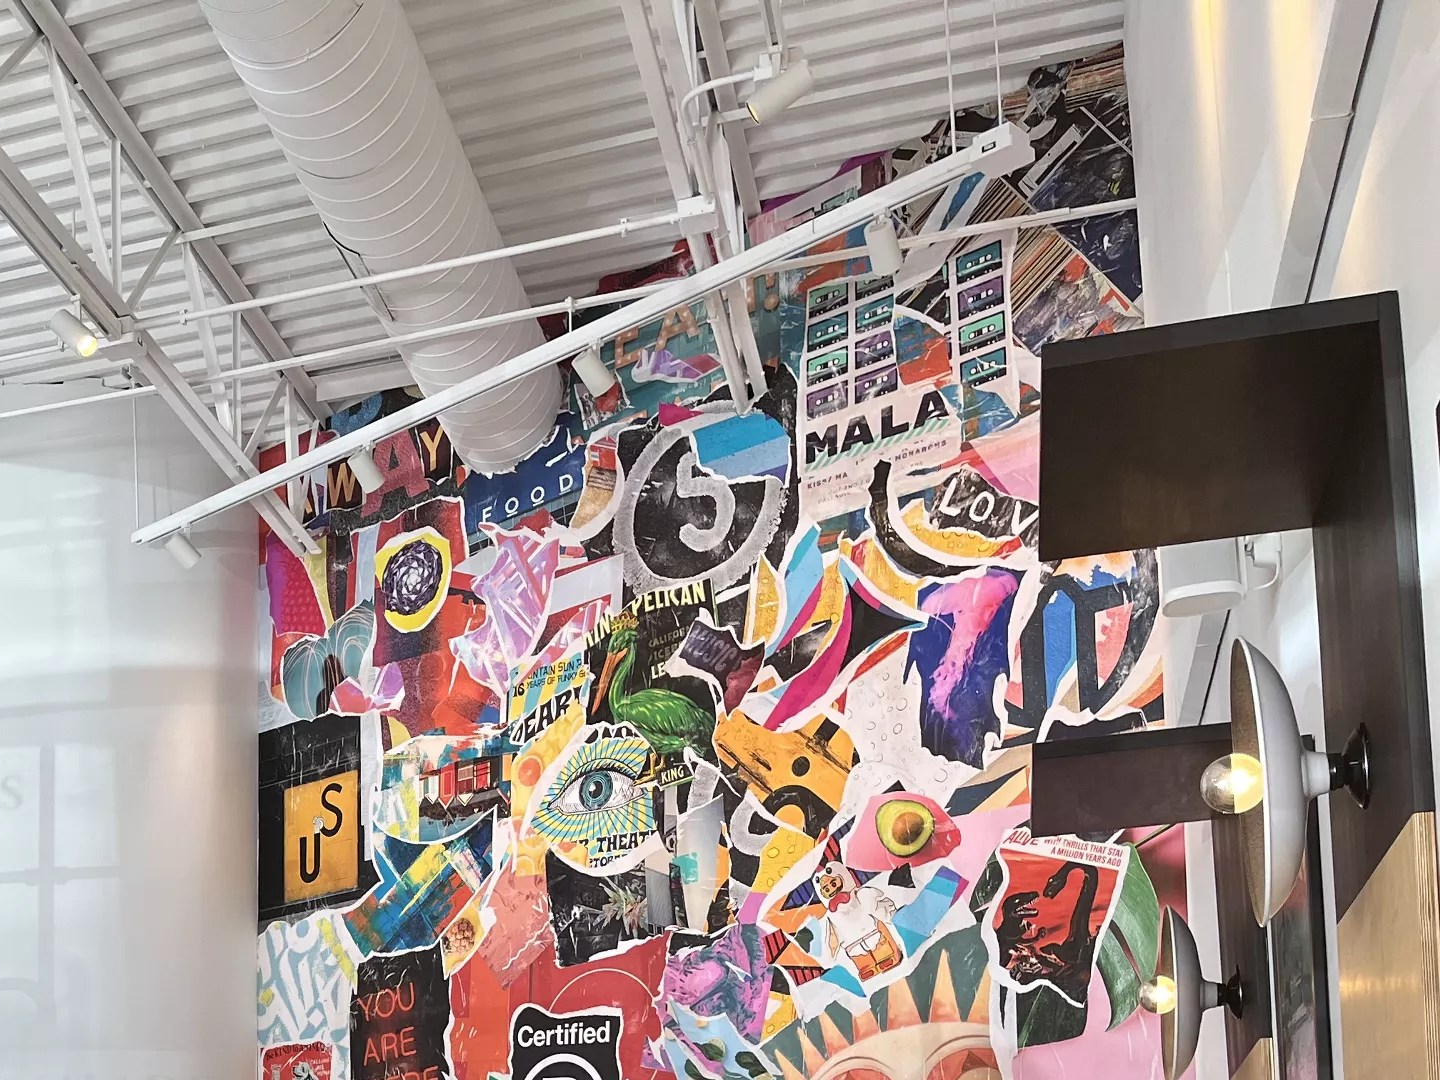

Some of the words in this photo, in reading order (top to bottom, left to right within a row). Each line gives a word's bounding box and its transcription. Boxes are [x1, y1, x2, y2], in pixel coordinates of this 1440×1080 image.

[805, 390, 950, 465] MALA
[482, 474, 574, 524] FOOD
[631, 580, 706, 617] PELICAN
[546, 676, 556, 685] OF
[661, 766, 684, 784] KING
[1003, 830, 1039, 846] ALIVE
[1062, 838, 1088, 851] THRILLS
[1090, 844, 1107, 854] THAT
[1057, 849, 1084, 860] MILLION
[1085, 853, 1106, 864] YEARS
[1106, 857, 1122, 867] AGO
[357, 981, 417, 1021] YOU
[363, 1028, 418, 1066] ARE
[517, 1020, 611, 1049] Certified
